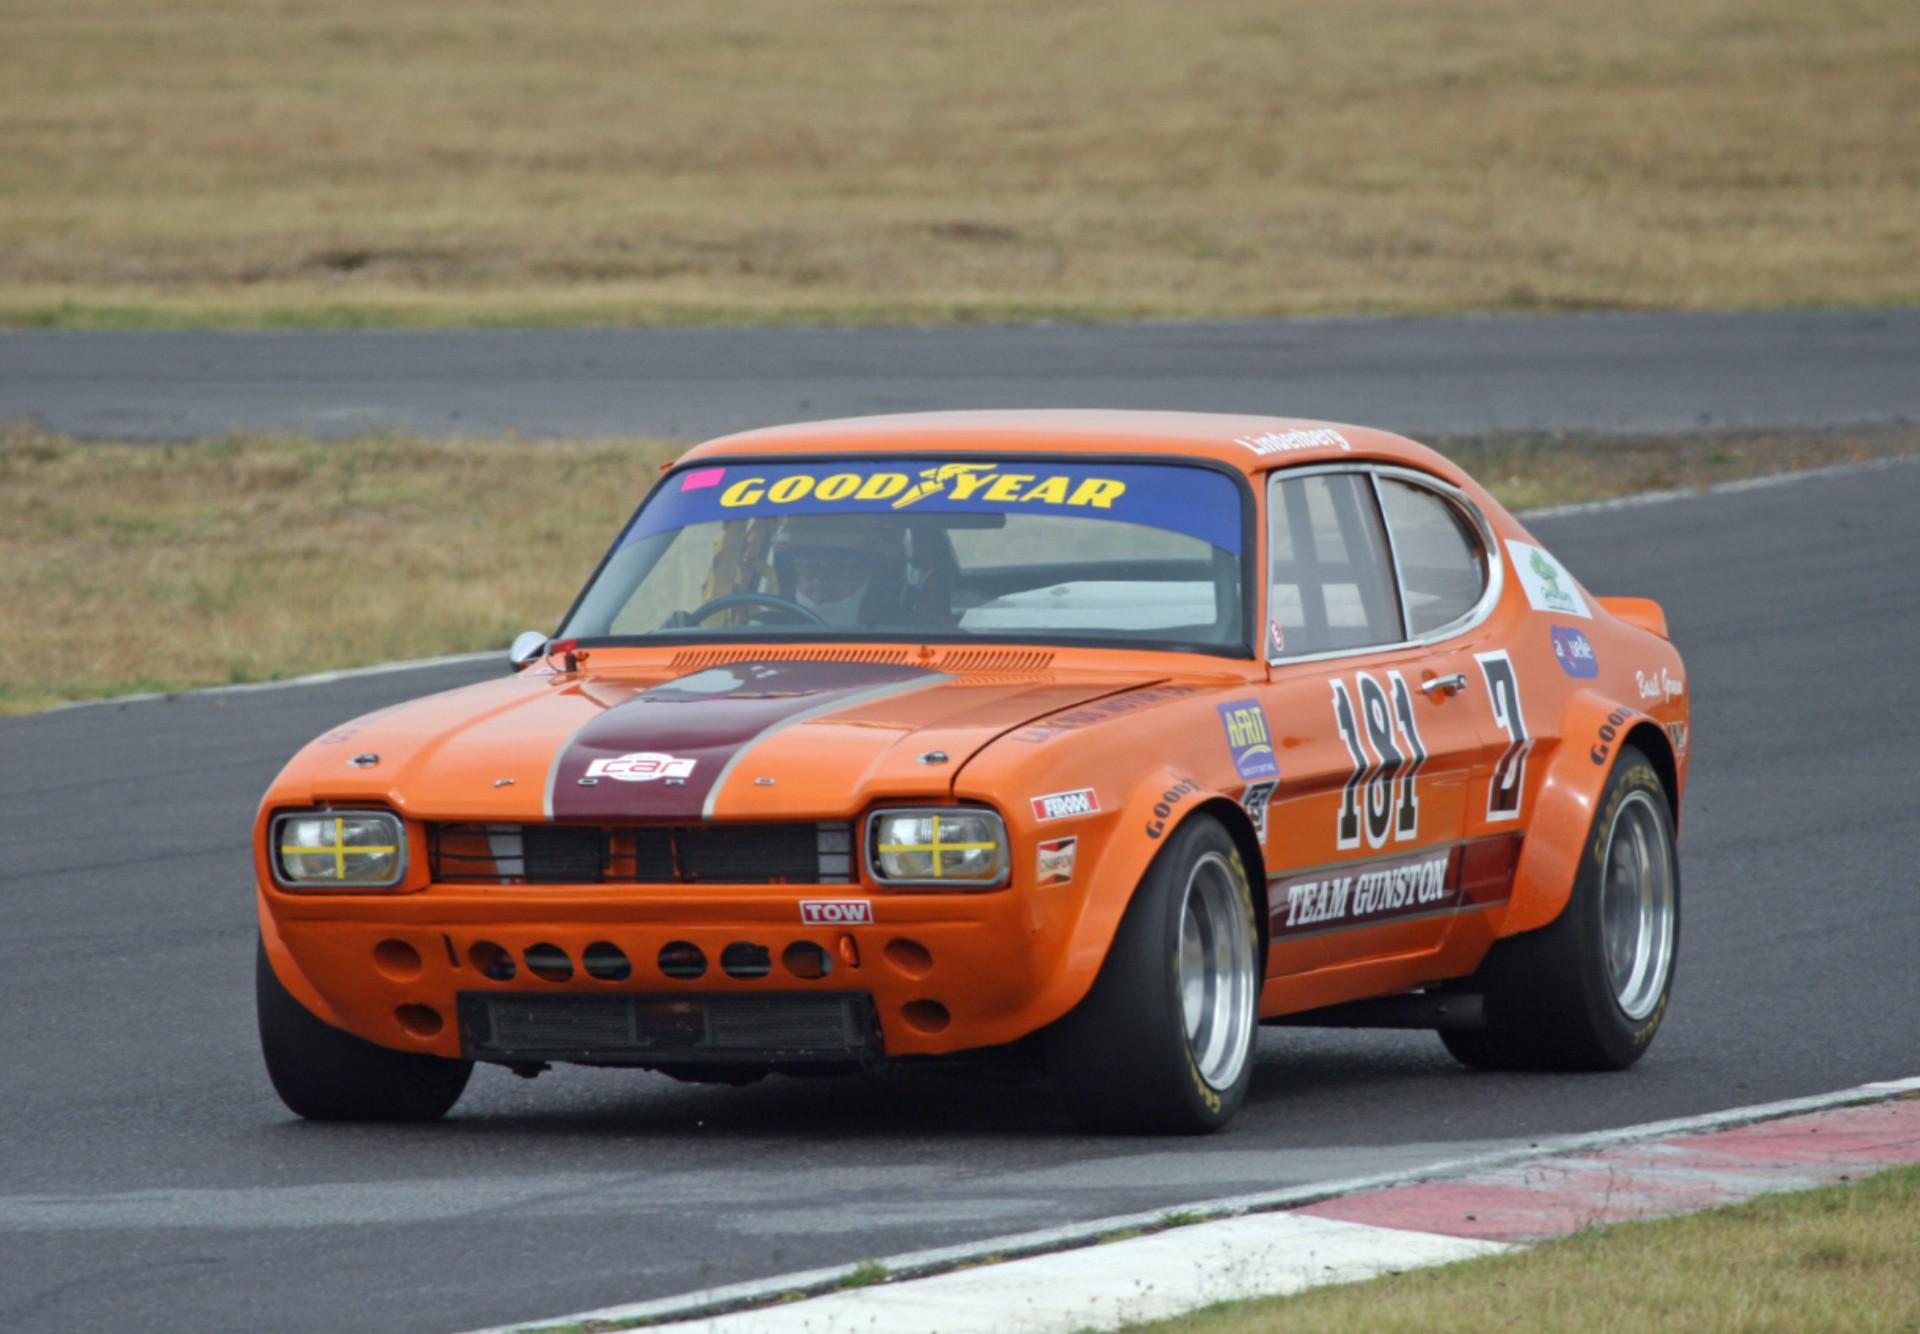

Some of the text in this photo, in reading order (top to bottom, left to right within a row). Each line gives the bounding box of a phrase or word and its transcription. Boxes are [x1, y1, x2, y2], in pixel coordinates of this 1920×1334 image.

[601, 759, 686, 774] car
[1329, 670, 1427, 851] 181
[807, 903, 868, 922] TOW
[1285, 876, 1352, 927] TEAM
[1353, 857, 1449, 917] GUNSTON
